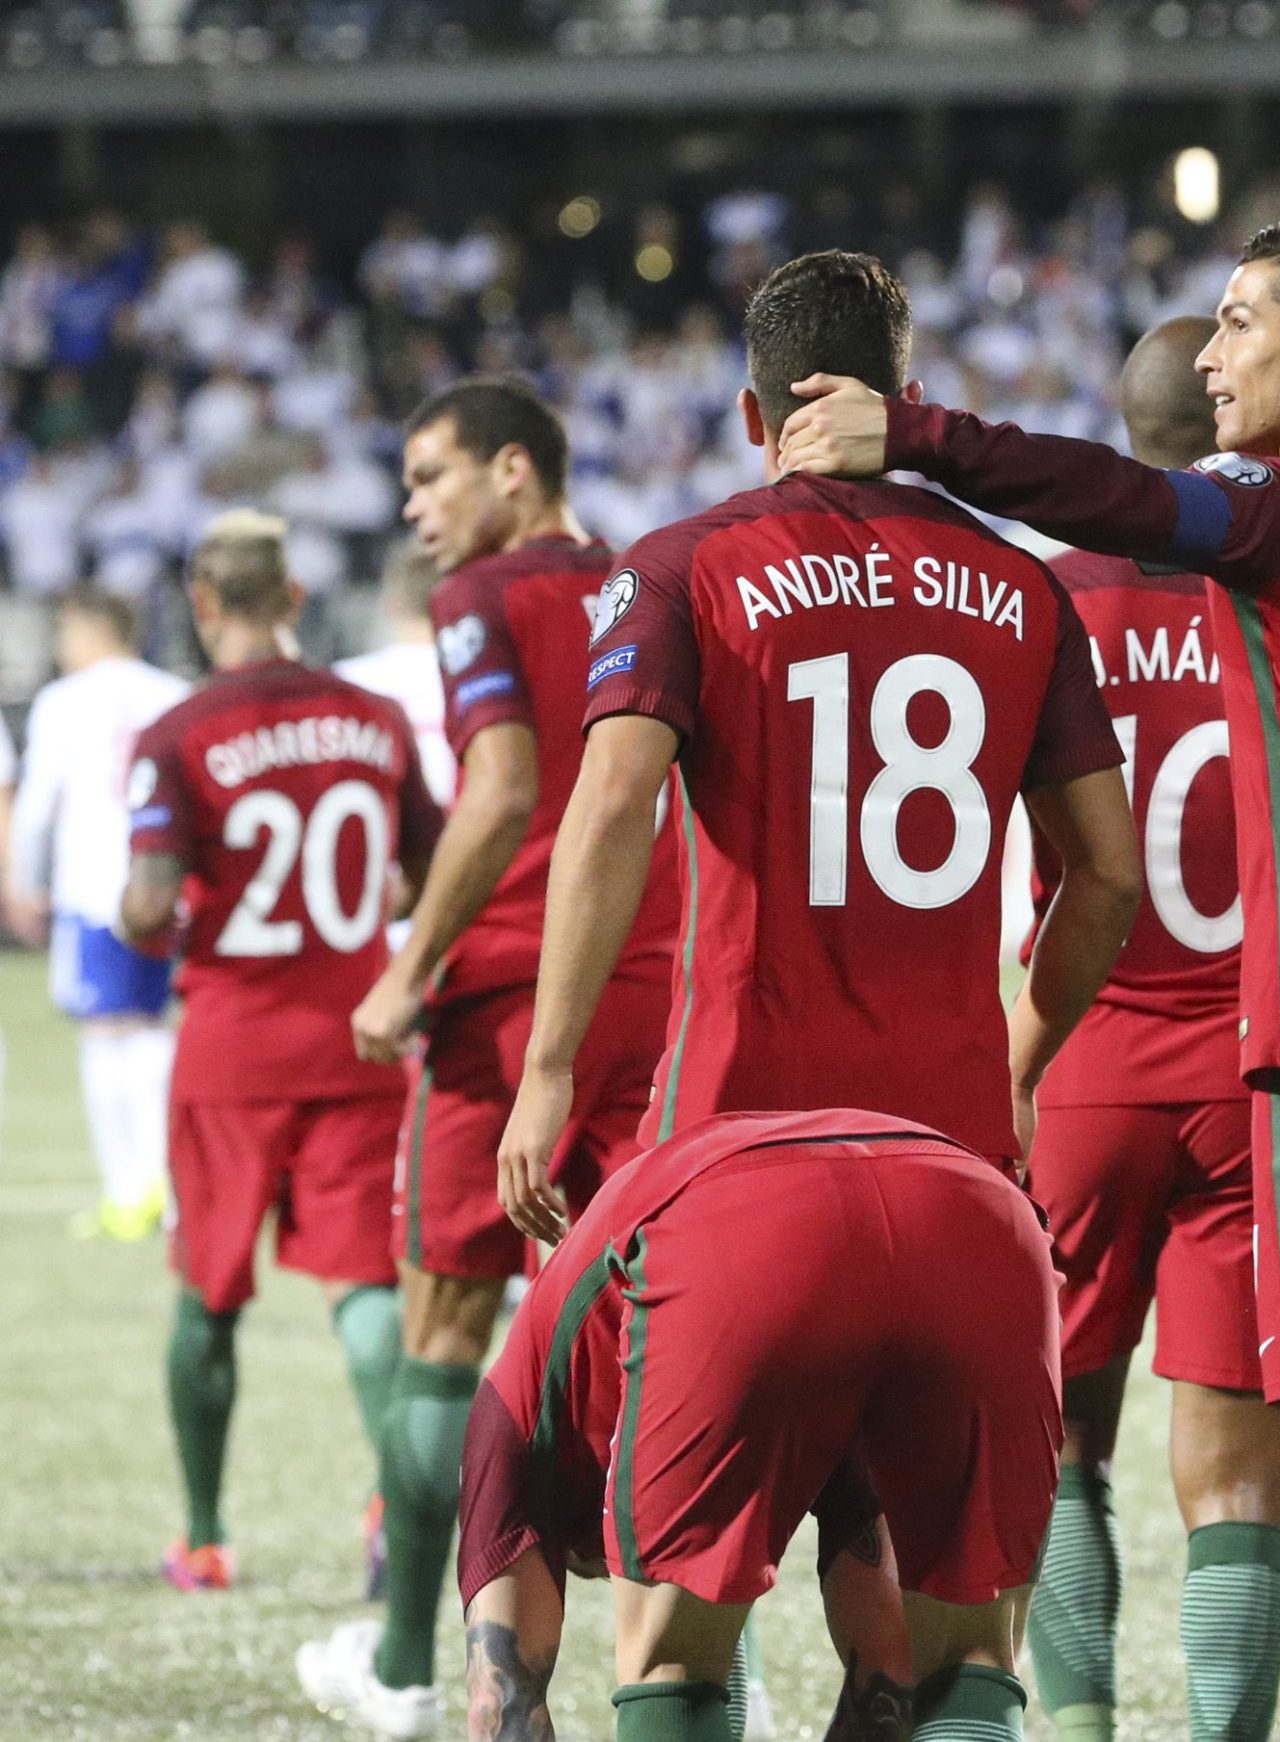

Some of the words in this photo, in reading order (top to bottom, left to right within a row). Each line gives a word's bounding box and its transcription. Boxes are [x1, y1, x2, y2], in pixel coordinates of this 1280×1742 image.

[736, 543, 895, 631] ANDRÉ
[913, 556, 1023, 641] SILVA
[1089, 615, 1220, 688] J.MÁ
[205, 715, 394, 788] QUARESMA
[787, 652, 991, 909] 18
[213, 779, 388, 956] 20
